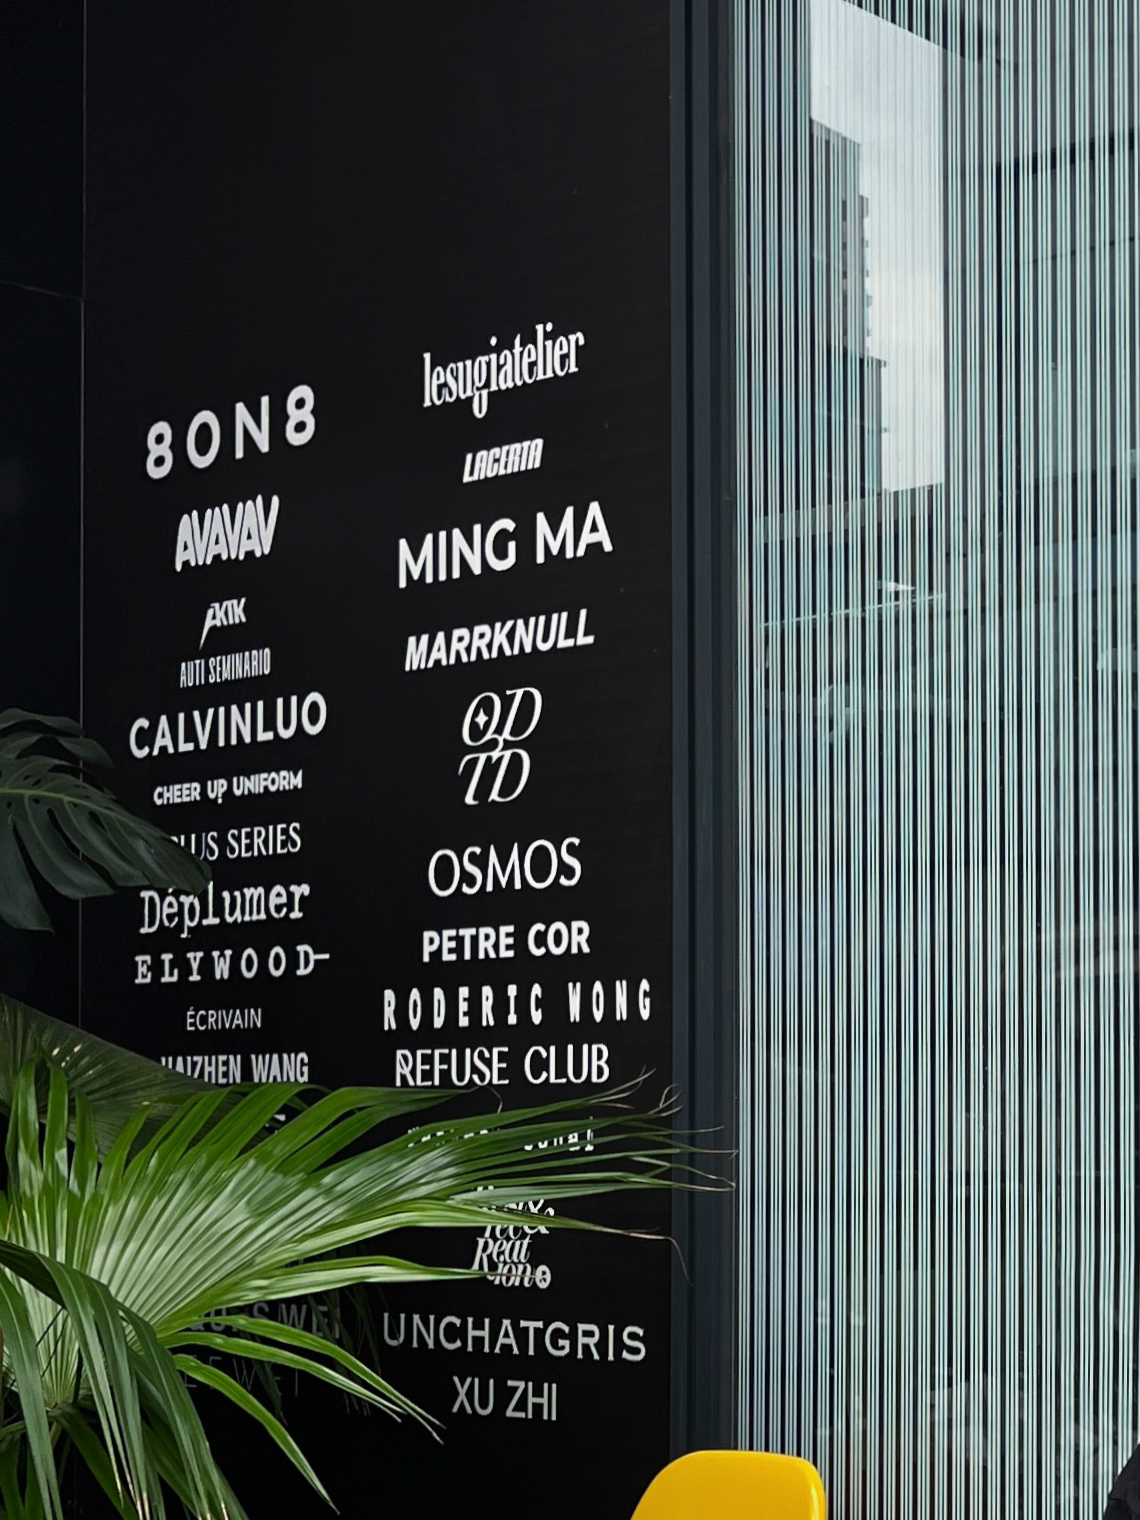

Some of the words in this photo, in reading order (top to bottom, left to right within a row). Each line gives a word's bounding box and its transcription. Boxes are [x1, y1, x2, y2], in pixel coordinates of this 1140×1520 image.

[422, 321, 585, 419] lesugiatelier
[146, 384, 316, 480] 8ON8
[462, 437, 544, 484] LACERTA
[175, 494, 280, 572] AVAVAV
[398, 517, 517, 589] MING
[535, 500, 614, 565] MA
[404, 608, 595, 672] MARRKNULL
[179, 658, 205, 689] AUTI
[208, 647, 271, 684] SEMINARIO
[129, 691, 327, 759] CALVINLUO
[153, 781, 201, 806] CHEER
[207, 778, 228, 804] UP
[232, 769, 303, 796] UNIFORM
[226, 822, 302, 859] SERIES
[428, 836, 582, 897] OSMOS
[139, 880, 311, 939] Déplumer
[422, 924, 515, 963] PETRE
[527, 920, 591, 957] COR
[186, 1006, 262, 1031] ÉCRIVAIN
[383, 982, 543, 1031] RODERIC
[567, 978, 651, 1023] WONG
[250, 1051, 309, 1084] WANG
[395, 1046, 510, 1087] REFUSE
[524, 1043, 610, 1085] CLUB
[384, 1312, 646, 1362] UNCHATGRIS
[452, 1375, 494, 1416] XU
[505, 1379, 557, 1421] ZHI
